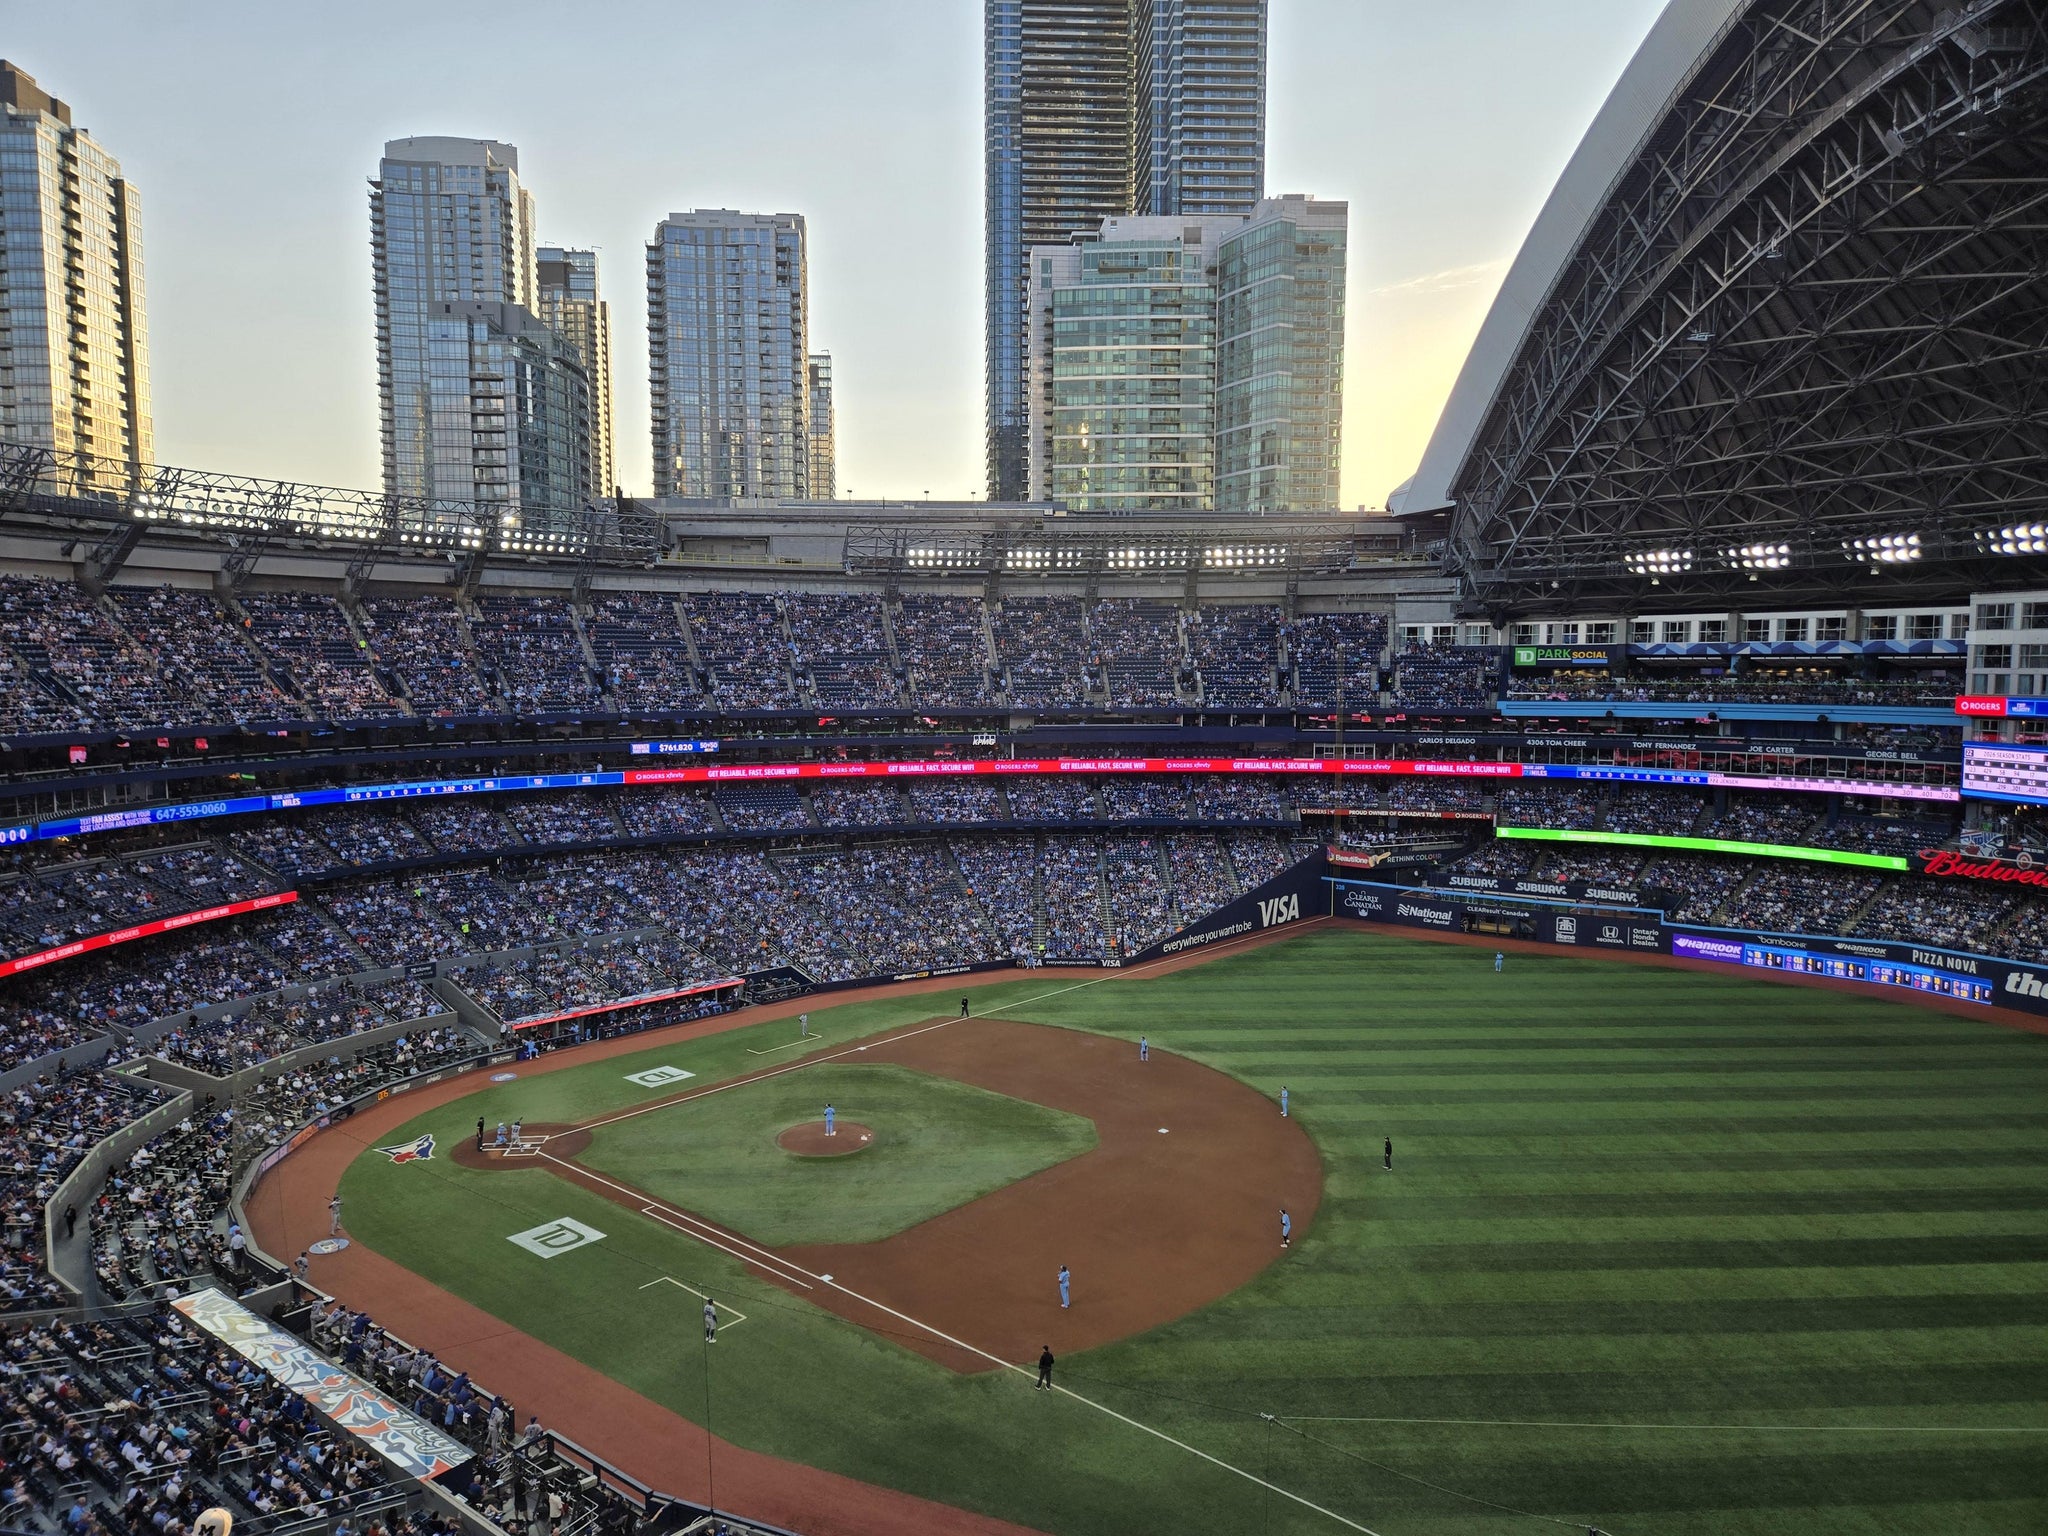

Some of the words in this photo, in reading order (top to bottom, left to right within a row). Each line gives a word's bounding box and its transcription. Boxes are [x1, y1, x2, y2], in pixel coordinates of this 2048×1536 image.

[1517, 650, 1535, 663] TD
[1538, 648, 1571, 658] PARK
[1970, 702, 2000, 710] ROGERS
[1655, 742, 1696, 750] FERNANDEZ
[1766, 746, 1794, 754] CARTER
[1866, 750, 1898, 759] GEORGE
[1901, 752, 1918, 760] BELL
[1061, 762, 1071, 770] GET
[764, 768, 786, 776] SECURE
[156, 802, 226, 820] 647-559-0060
[91, 816, 103, 824] FAN
[104, 814, 123, 823] ASSIST
[124, 812, 138, 820] WITH
[10, 830, 16, 841] 0
[20, 828, 26, 840] 0
[1449, 876, 1499, 888] SUBWAY
[1515, 882, 1567, 895] SUBWAY
[1348, 892, 1379, 902] CLEARLY
[1585, 888, 1637, 902] SUBWAY
[261, 897, 280, 905] ROGERS
[1344, 898, 1382, 910] CANADIAN
[1257, 893, 1299, 927] VISA
[1502, 909, 1524, 917] Canada
[116, 929, 139, 940] ROGERS
[1163, 934, 1204, 952] everywhere
[1205, 930, 1218, 943] you
[1219, 924, 1235, 937] want
[1236, 924, 1243, 932] to
[1243, 921, 1252, 930] be
[1633, 928, 1659, 936] Ontario
[1024, 959, 1042, 967] VSA
[1912, 949, 1943, 967] PIZZA
[1947, 957, 1976, 974] NOVA
[1975, 992, 1979, 1000] 3
[532, 1224, 585, 1249] TD
